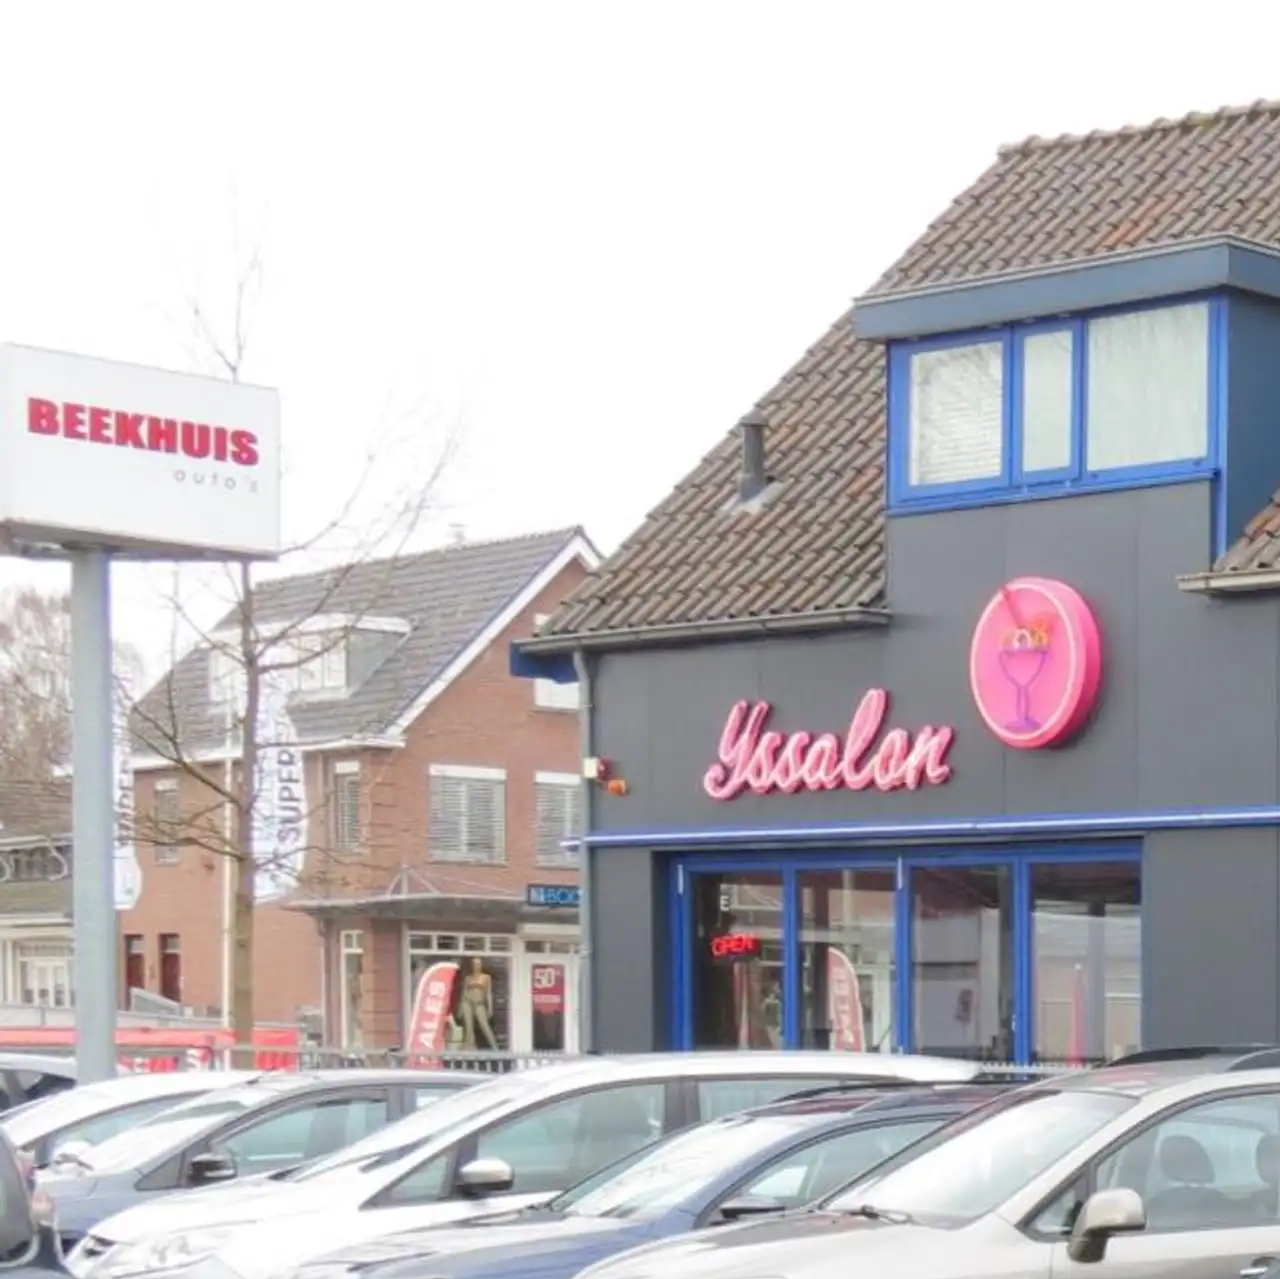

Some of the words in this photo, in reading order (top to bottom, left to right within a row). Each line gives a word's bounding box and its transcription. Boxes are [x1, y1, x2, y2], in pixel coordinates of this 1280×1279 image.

[28, 397, 259, 467] BEEKHUIS
[173, 469, 258, 494] auto's
[704, 687, 954, 800] Yssalon
[711, 933, 755, 957] OPEN
